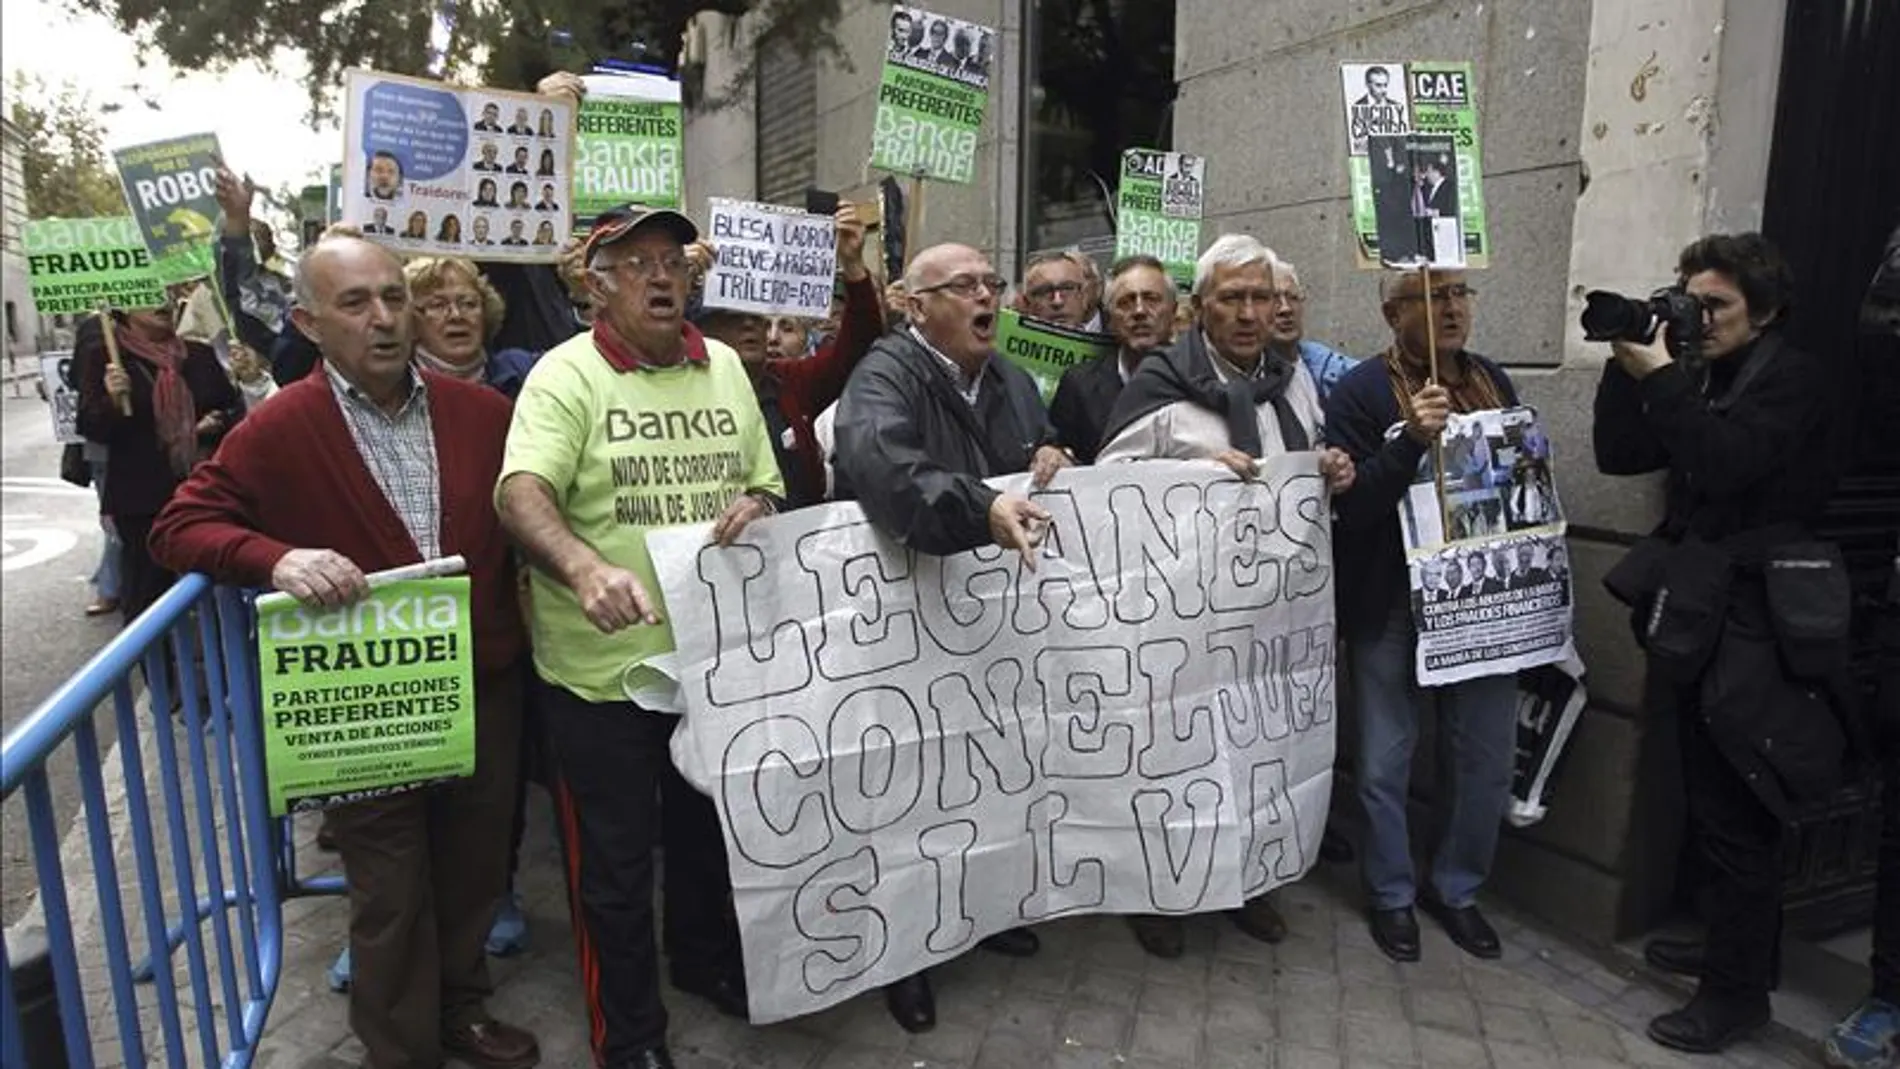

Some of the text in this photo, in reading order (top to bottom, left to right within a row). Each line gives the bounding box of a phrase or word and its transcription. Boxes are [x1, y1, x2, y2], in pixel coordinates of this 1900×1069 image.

[881, 84, 982, 126] PREFERENTES
[577, 114, 677, 138] REFERENTES
[876, 106, 977, 154] Bankia
[575, 136, 677, 168] Bankia
[873, 138, 974, 183] FRAUDE!
[713, 212, 776, 245] BLESA
[1120, 209, 1199, 242] Bankia
[28, 249, 150, 276] FRAUDE
[35, 290, 167, 313] PREFEENTES
[1006, 336, 1075, 366] CONTRA
[607, 407, 739, 443] Bankia
[611, 455, 650, 487] NIDO
[653, 455, 672, 486] DE
[614, 493, 664, 526] RUINA
[666, 493, 687, 524] DE
[699, 471, 1331, 706] LEGANES
[274, 632, 458, 675] FRAUDE!
[272, 676, 461, 708] PARTICIPACIONES
[1206, 623, 1333, 748] JUEZ
[275, 694, 461, 729] PREFERENTES
[284, 719, 453, 747] VENTA DE ACCIONES
[793, 758, 1305, 994] SILVA
